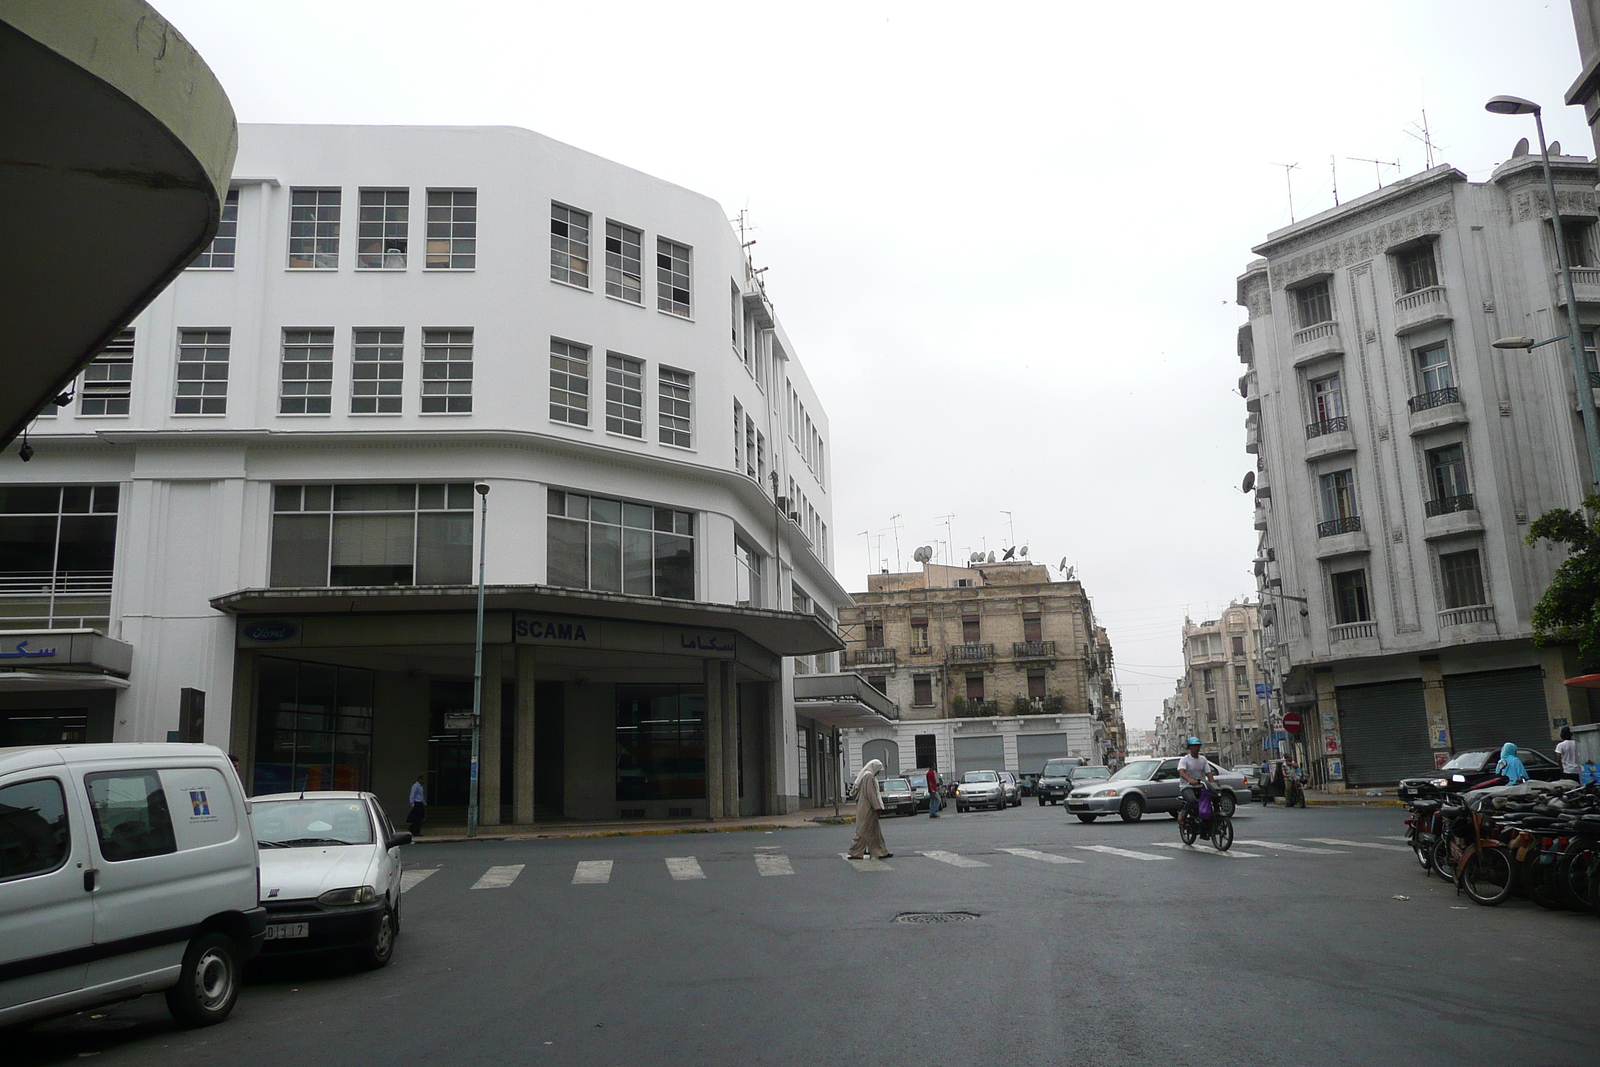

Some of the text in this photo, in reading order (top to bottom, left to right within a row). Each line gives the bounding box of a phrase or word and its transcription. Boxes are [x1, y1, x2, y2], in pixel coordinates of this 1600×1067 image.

[252, 627, 287, 639] Ford
[516, 620, 587, 641] SCAMA
[681, 633, 734, 651] سكاما
